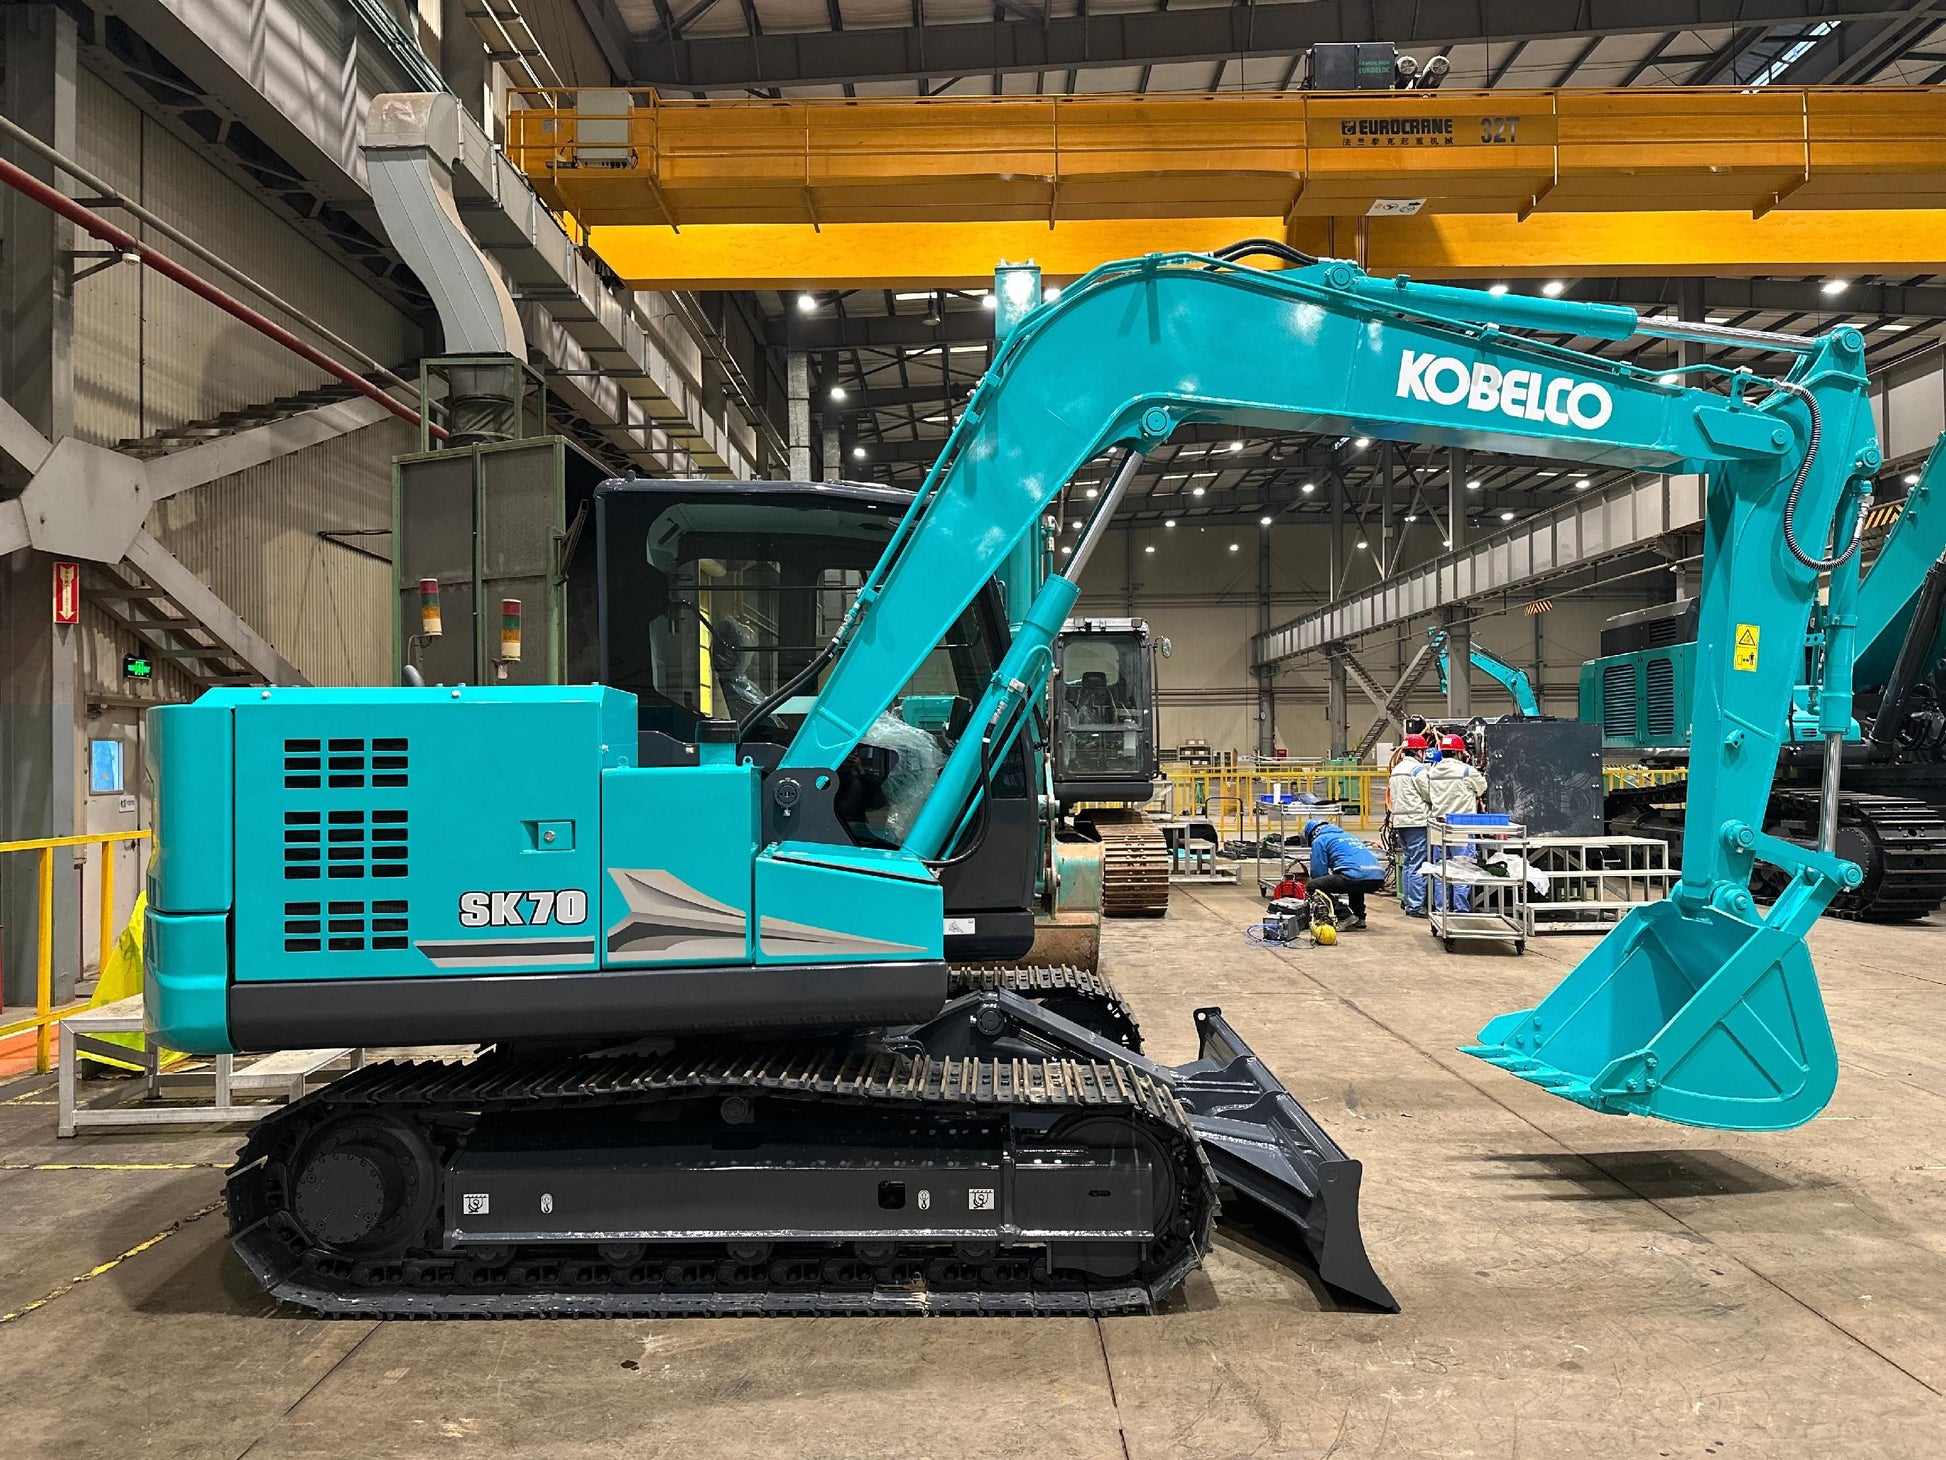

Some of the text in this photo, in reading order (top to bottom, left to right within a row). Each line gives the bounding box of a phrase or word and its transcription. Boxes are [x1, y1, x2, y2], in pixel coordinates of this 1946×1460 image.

[1359, 118, 1453, 135] EUROCRANE
[1480, 116, 1520, 144] 32T
[1396, 349, 1613, 430] KOBELCO
[459, 888, 588, 928] SK70
